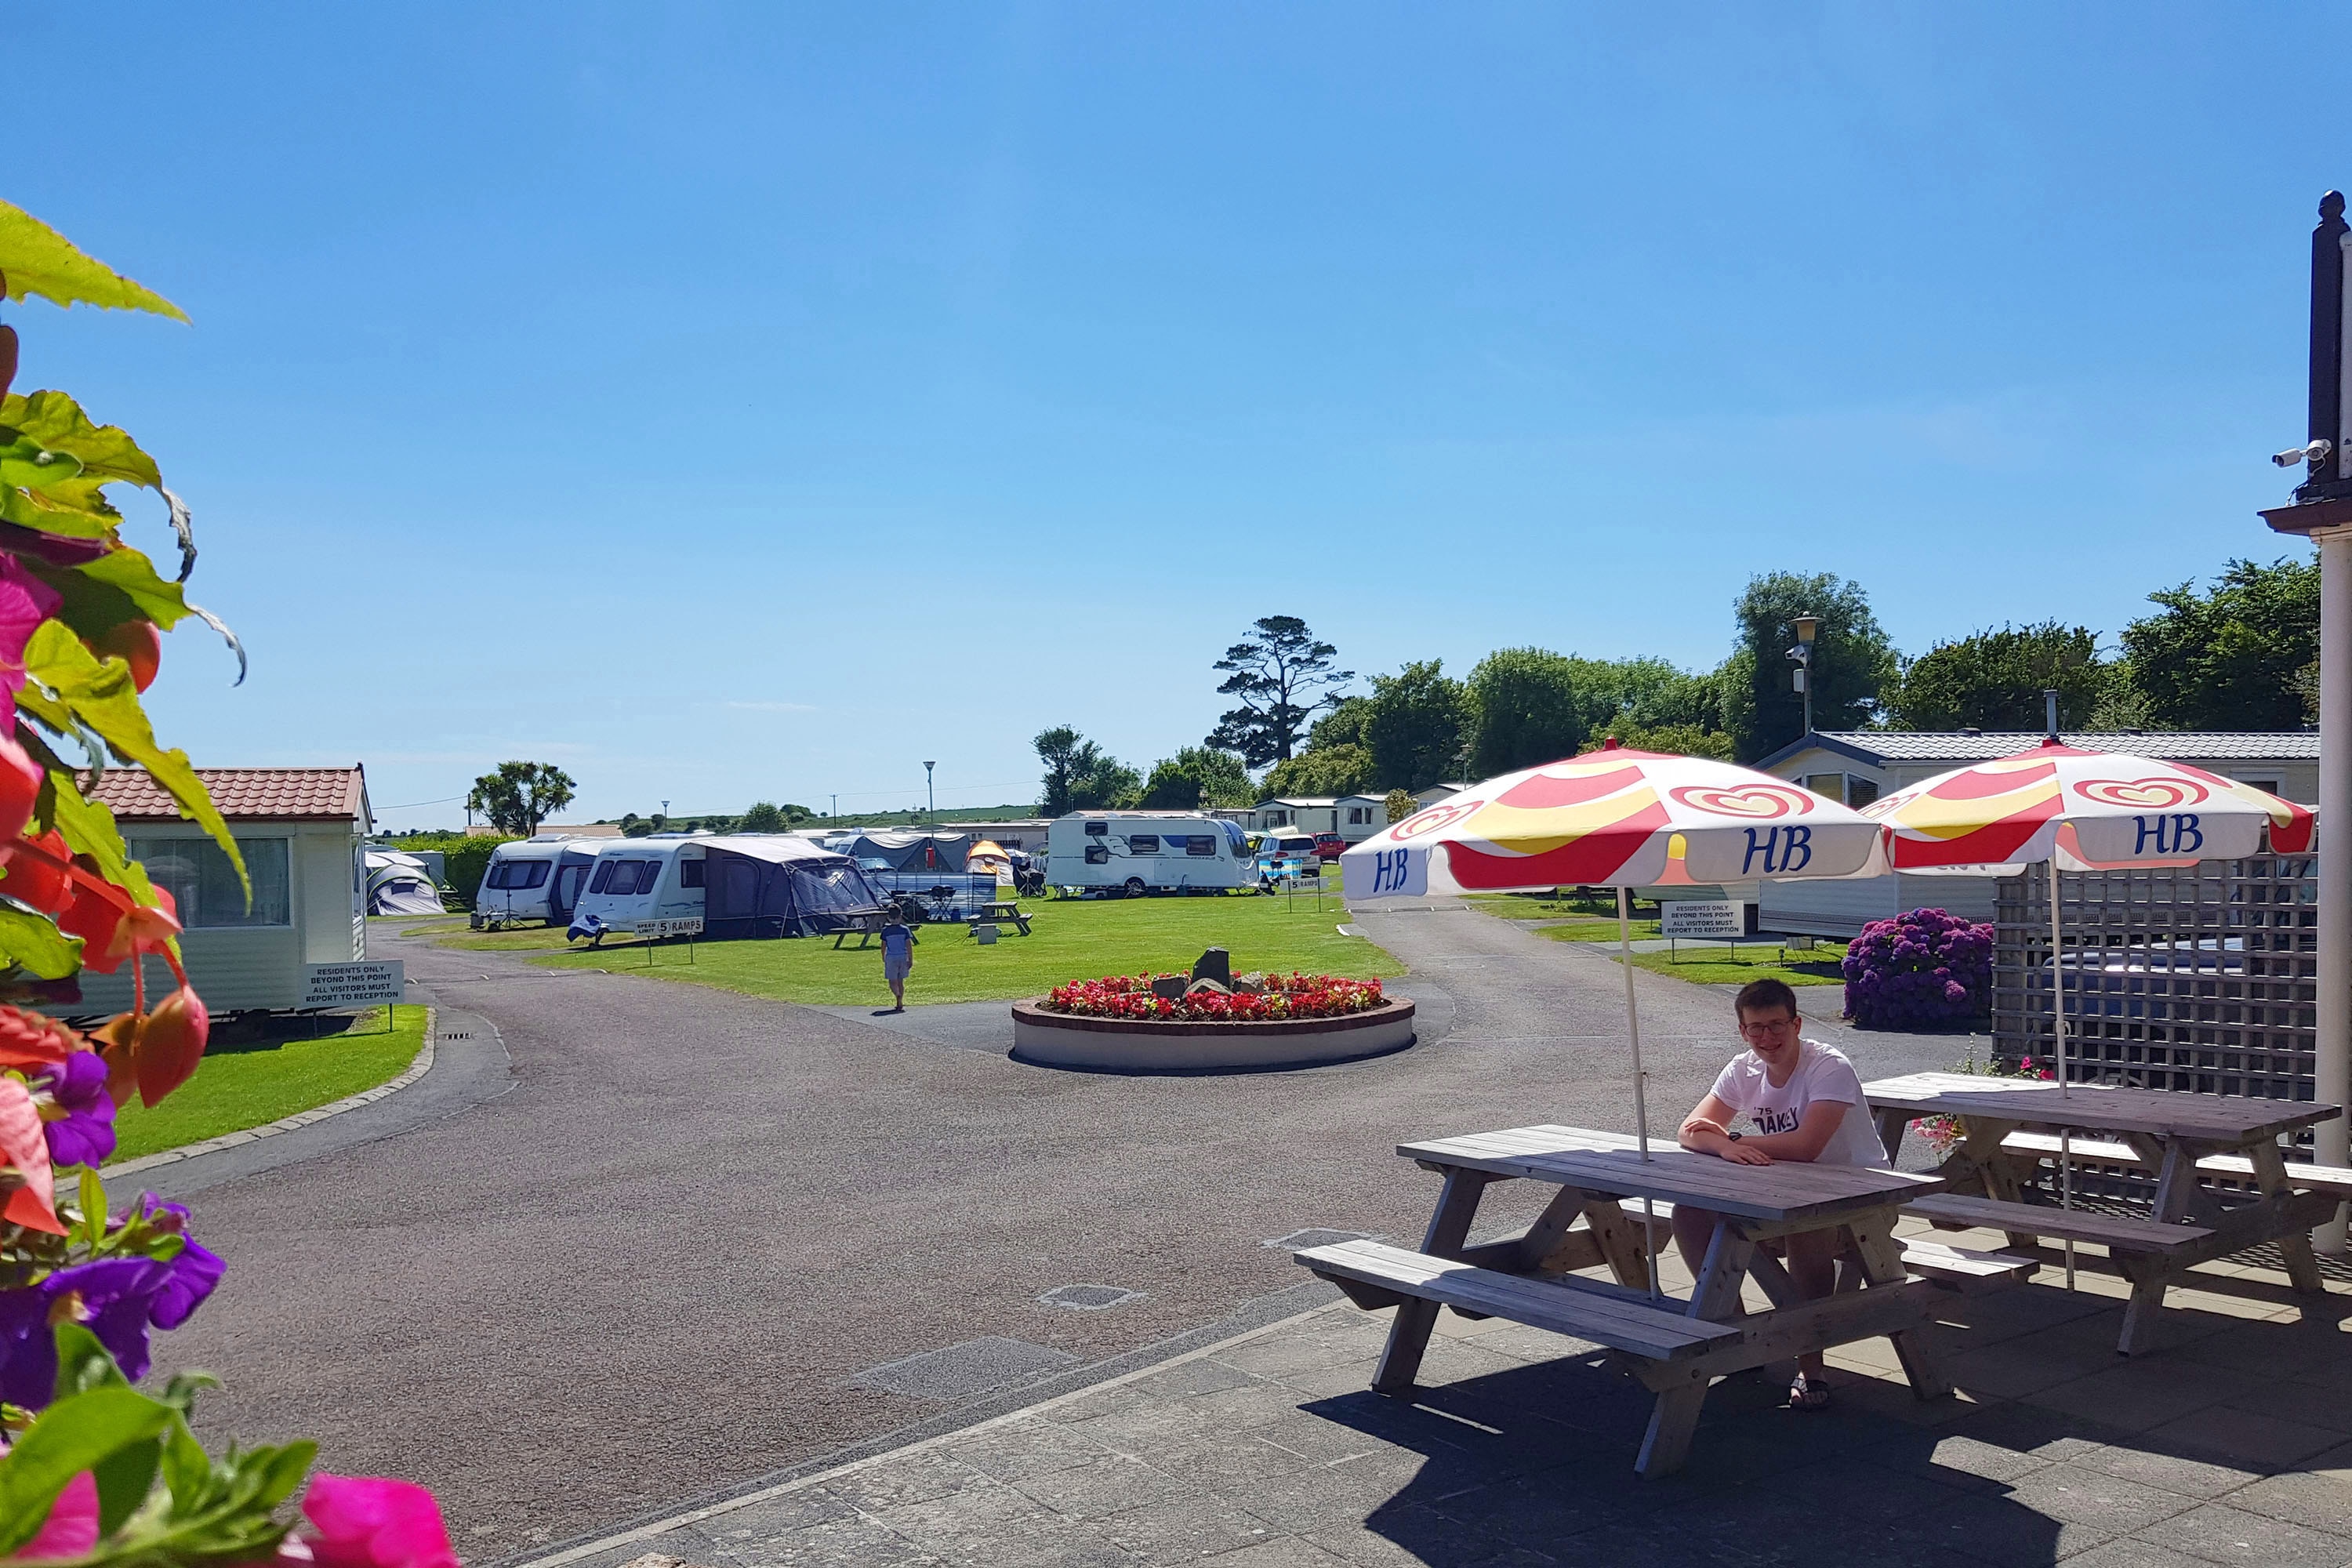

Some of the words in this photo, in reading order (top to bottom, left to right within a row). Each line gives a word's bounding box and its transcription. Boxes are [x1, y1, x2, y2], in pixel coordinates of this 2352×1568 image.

[2132, 814, 2203, 855] HB
[1742, 825, 1812, 874] HB
[1374, 848, 1408, 893] HB
[660, 923, 667, 931] 5
[672, 920, 701, 931] RAMPS
[317, 966, 361, 975] RESIDENTS
[311, 975, 344, 984] BEYOND
[330, 984, 366, 993] VISITORS
[306, 994, 338, 1003] REPORT
[354, 991, 399, 1000] RECEPTION
[1754, 1106, 1773, 1116] '75
